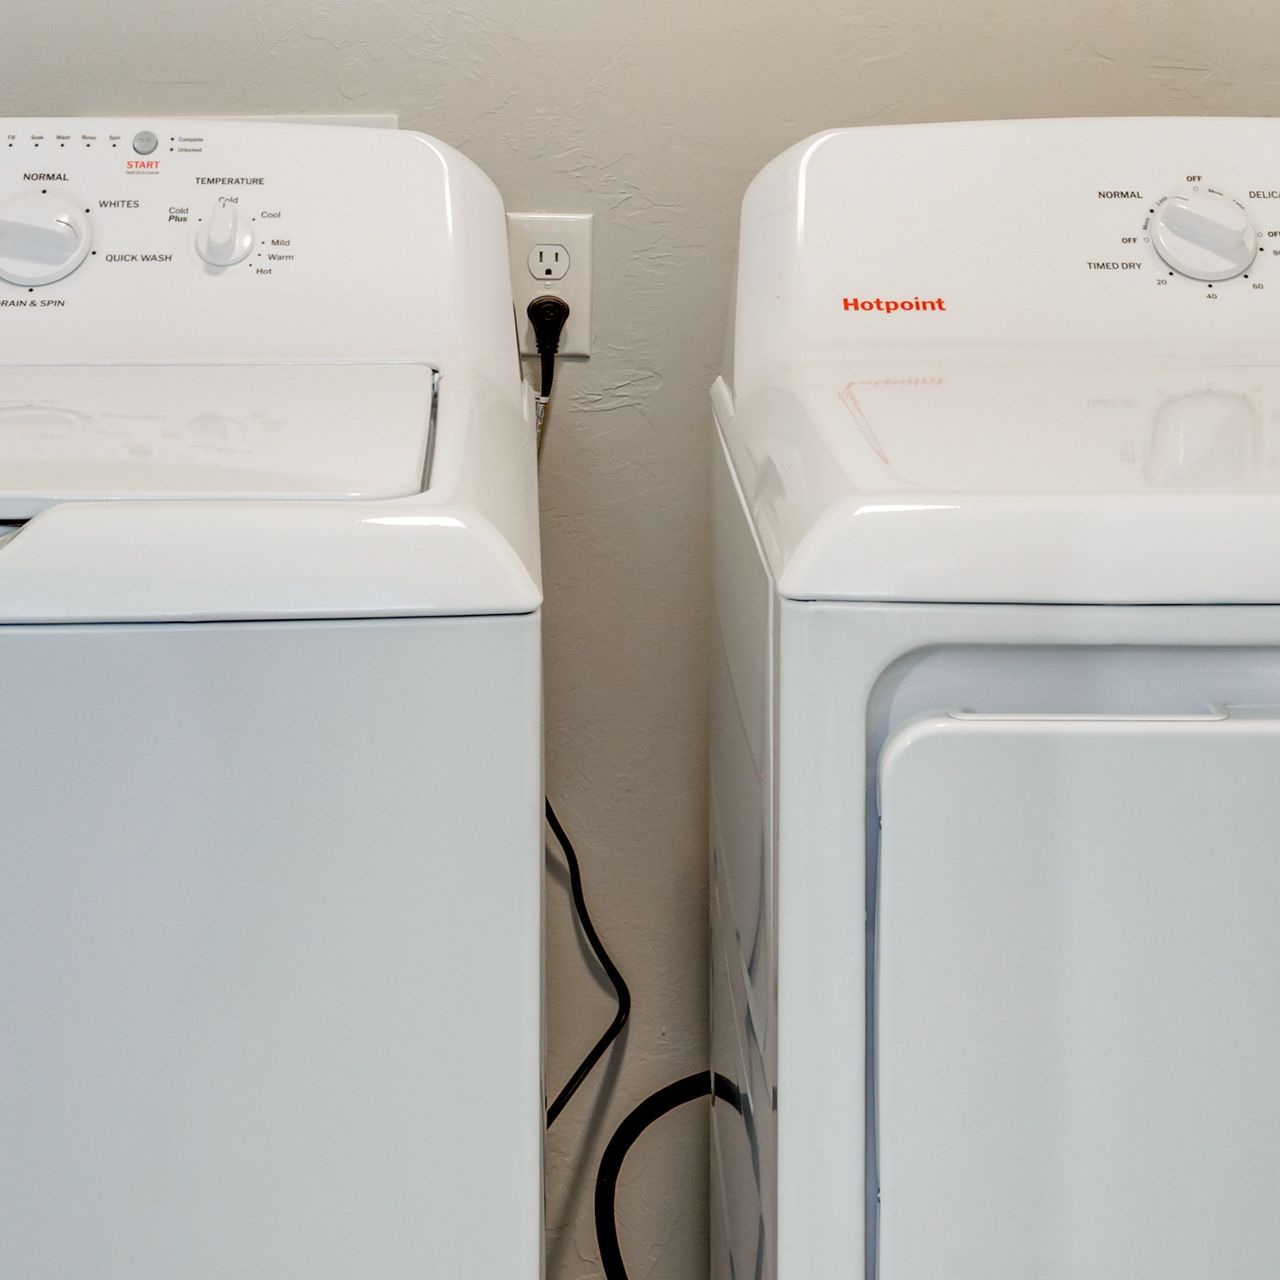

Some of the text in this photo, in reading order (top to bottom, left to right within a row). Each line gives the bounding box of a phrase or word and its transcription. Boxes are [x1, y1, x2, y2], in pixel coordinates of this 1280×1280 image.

[126, 160, 160, 169] START
[23, 173, 69, 181] NORMAL
[195, 177, 264, 185] TEMPERATURE
[1098, 191, 1143, 199] NORMAL
[98, 200, 140, 208] WHITES
[1156, 196, 1168, 206] Less
[168, 206, 188, 214] Cold
[1142, 217, 1150, 230] More
[105, 254, 172, 262] QUICK WASH
[1087, 262, 1142, 270] TIMED DRY
[29, 300, 37, 308] &
[40, 300, 65, 308] SPIN
[842, 296, 946, 314] Hotpoint
